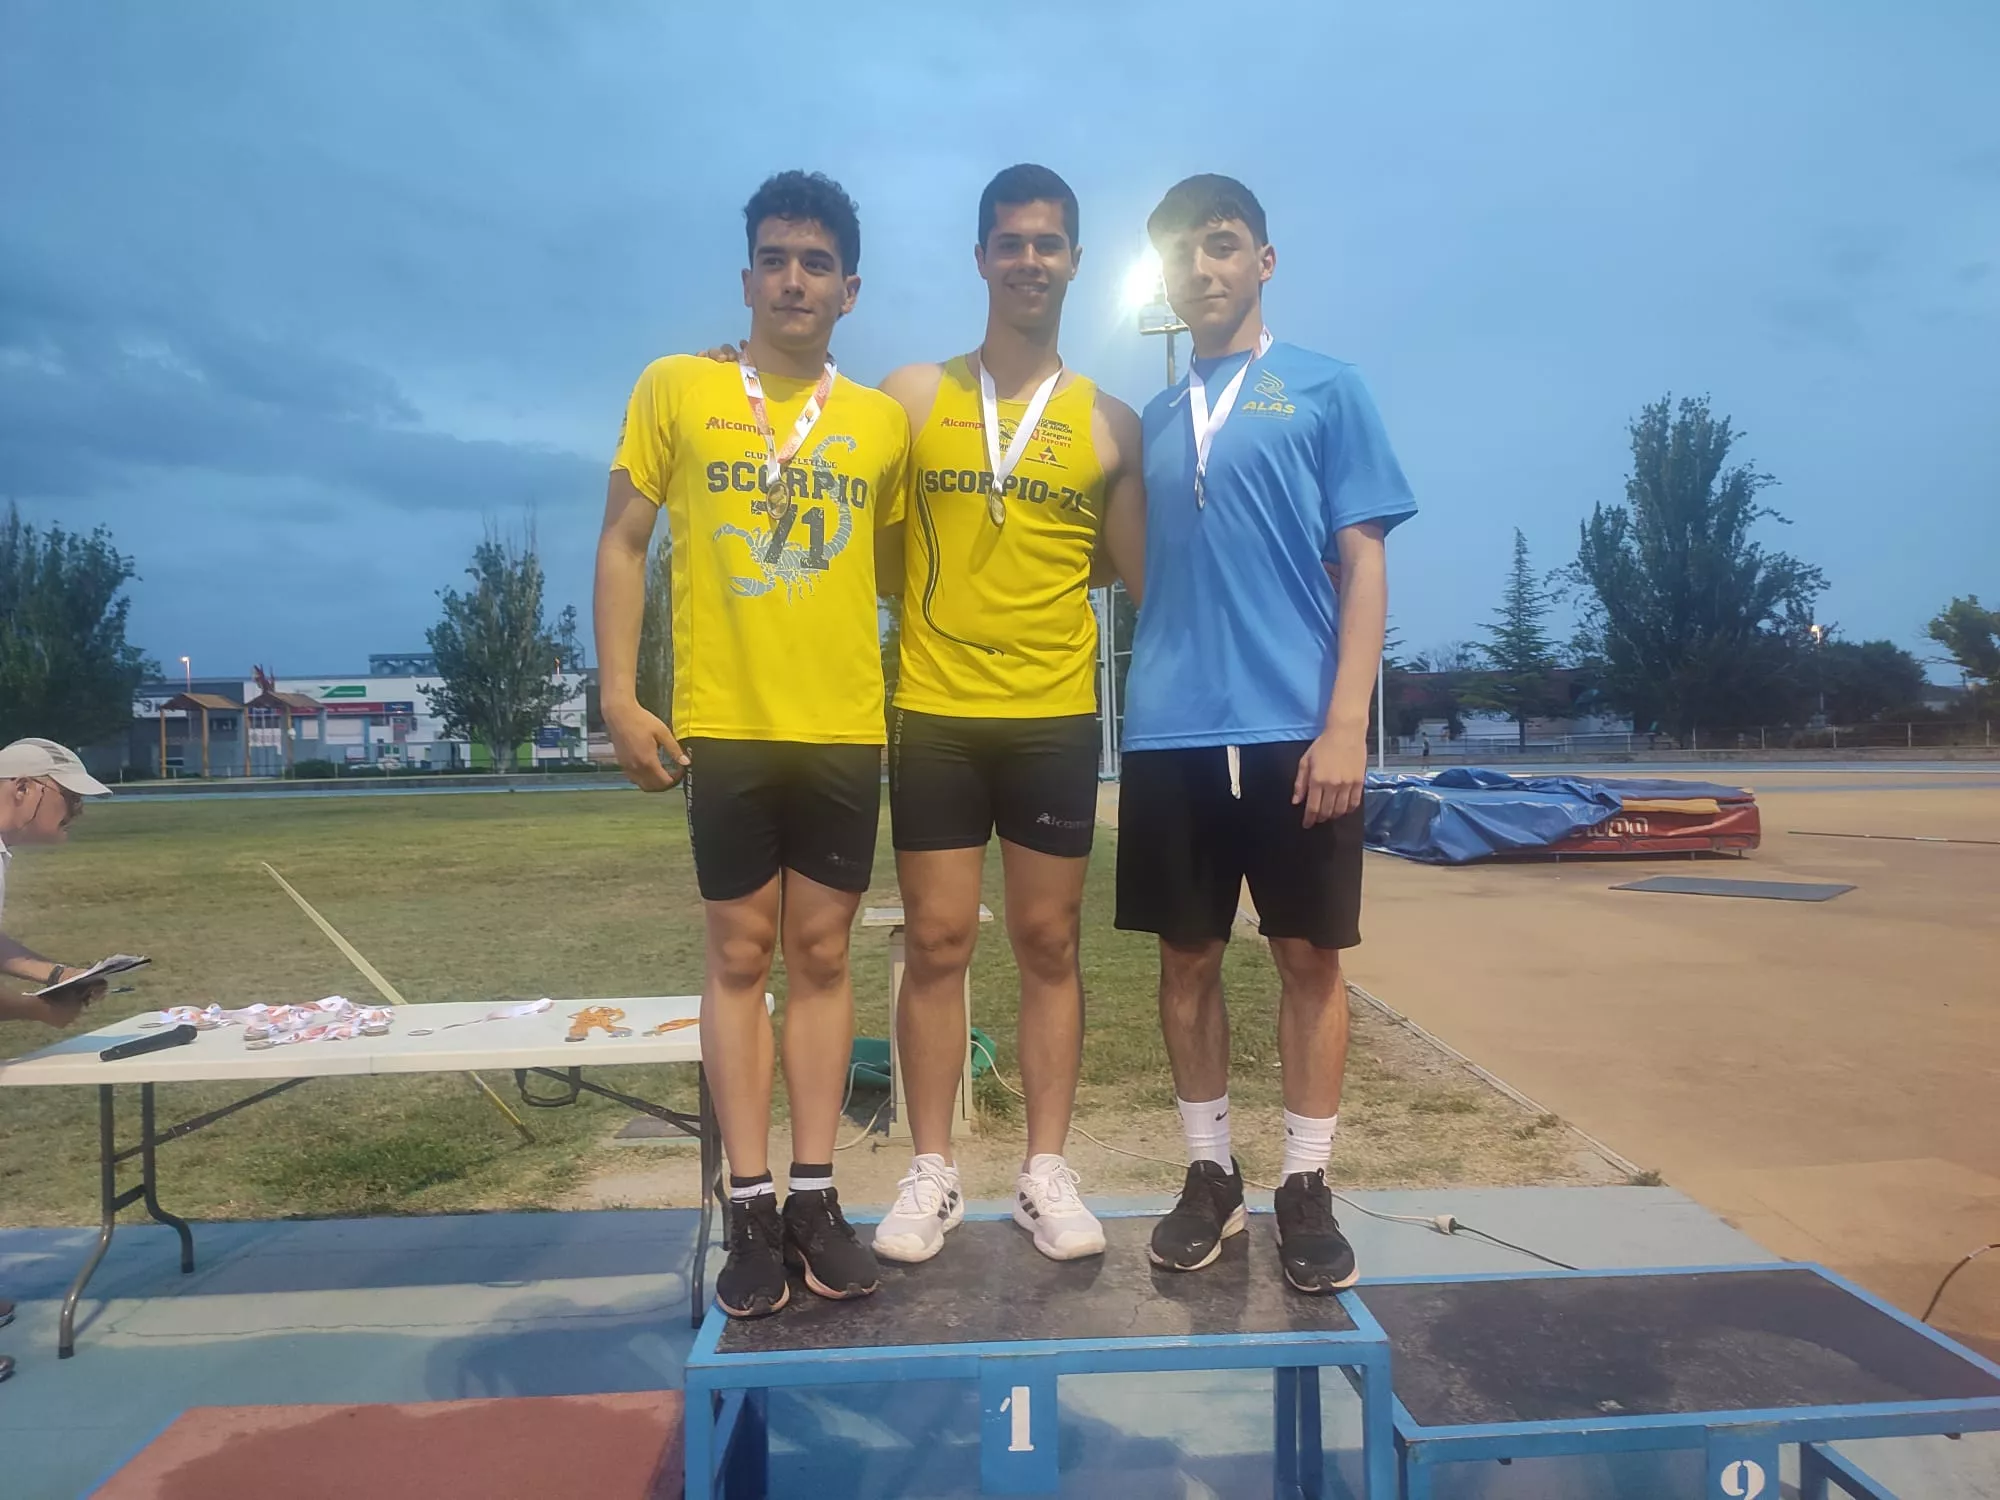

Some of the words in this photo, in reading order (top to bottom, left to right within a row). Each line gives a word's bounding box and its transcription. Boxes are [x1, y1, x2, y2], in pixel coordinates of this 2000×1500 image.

[941, 417, 985, 431] Alcamp
[1242, 401, 1296, 414] ALAS
[751, 500, 829, 570] 71
[1000, 1386, 1034, 1451] 1
